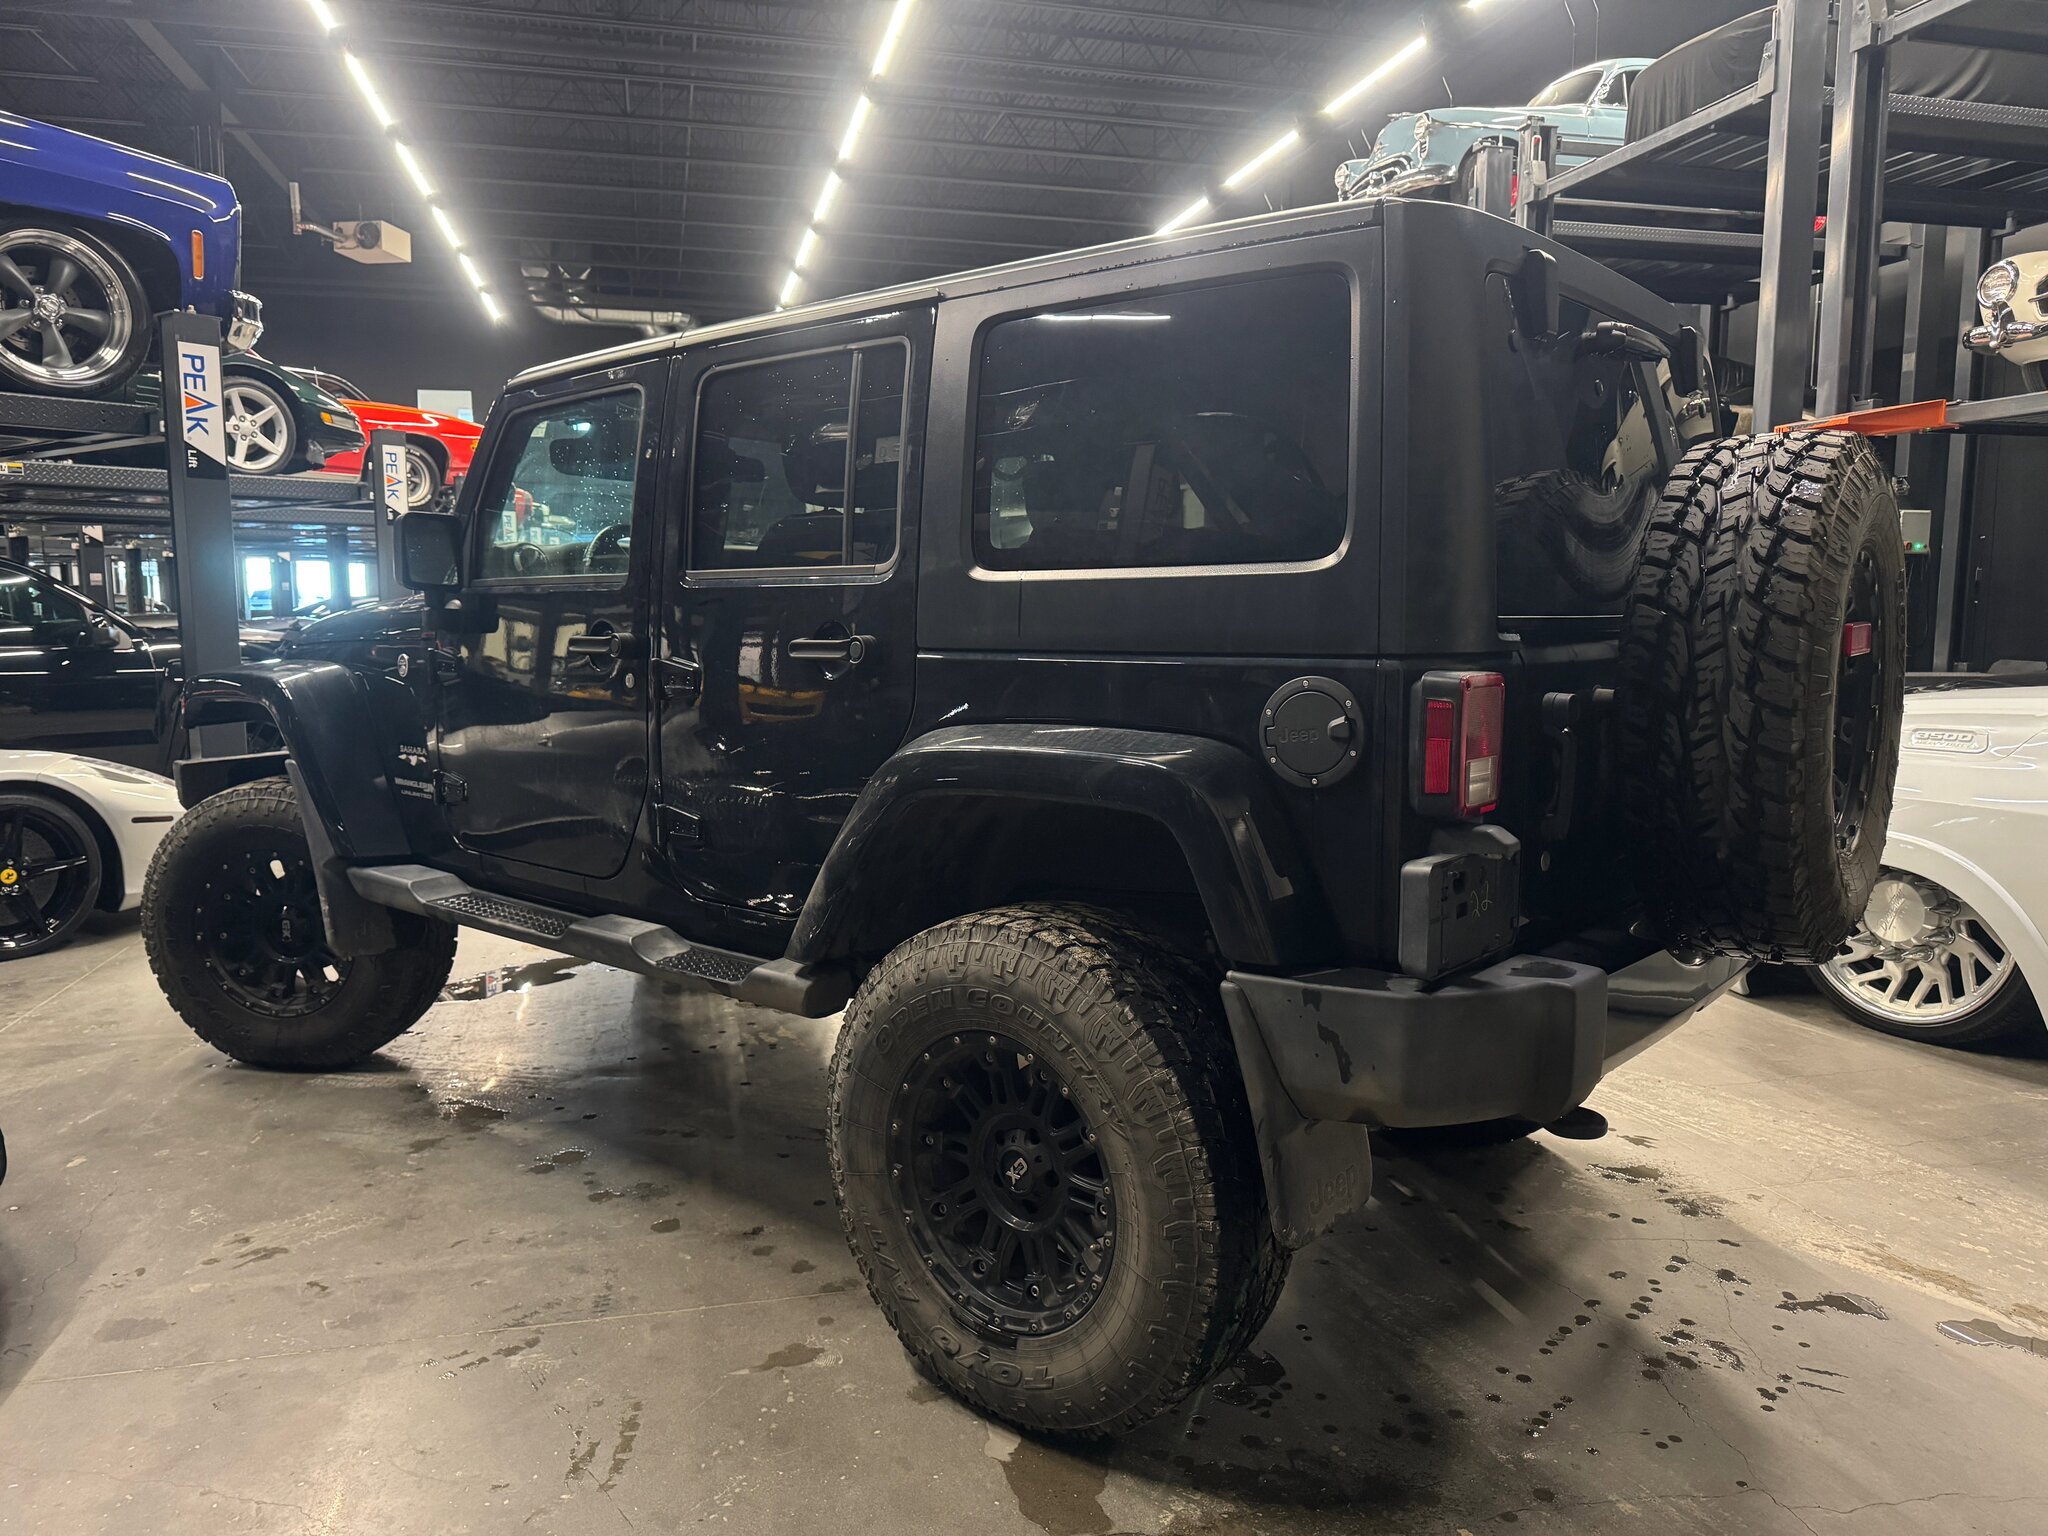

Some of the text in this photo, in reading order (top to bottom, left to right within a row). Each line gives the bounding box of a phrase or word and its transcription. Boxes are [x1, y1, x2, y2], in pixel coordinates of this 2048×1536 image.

[182, 353, 219, 435] PEAK
[187, 449, 198, 468] Lift
[385, 451, 403, 499] PEAK
[400, 744, 428, 755] SAHARA
[1279, 727, 1320, 744] Jeep
[1915, 732, 1975, 743] 3500
[875, 986, 1130, 1141] OPEN COUNTRY
[1005, 1157, 1028, 1186] XD
[928, 1325, 1055, 1392] TOYO
